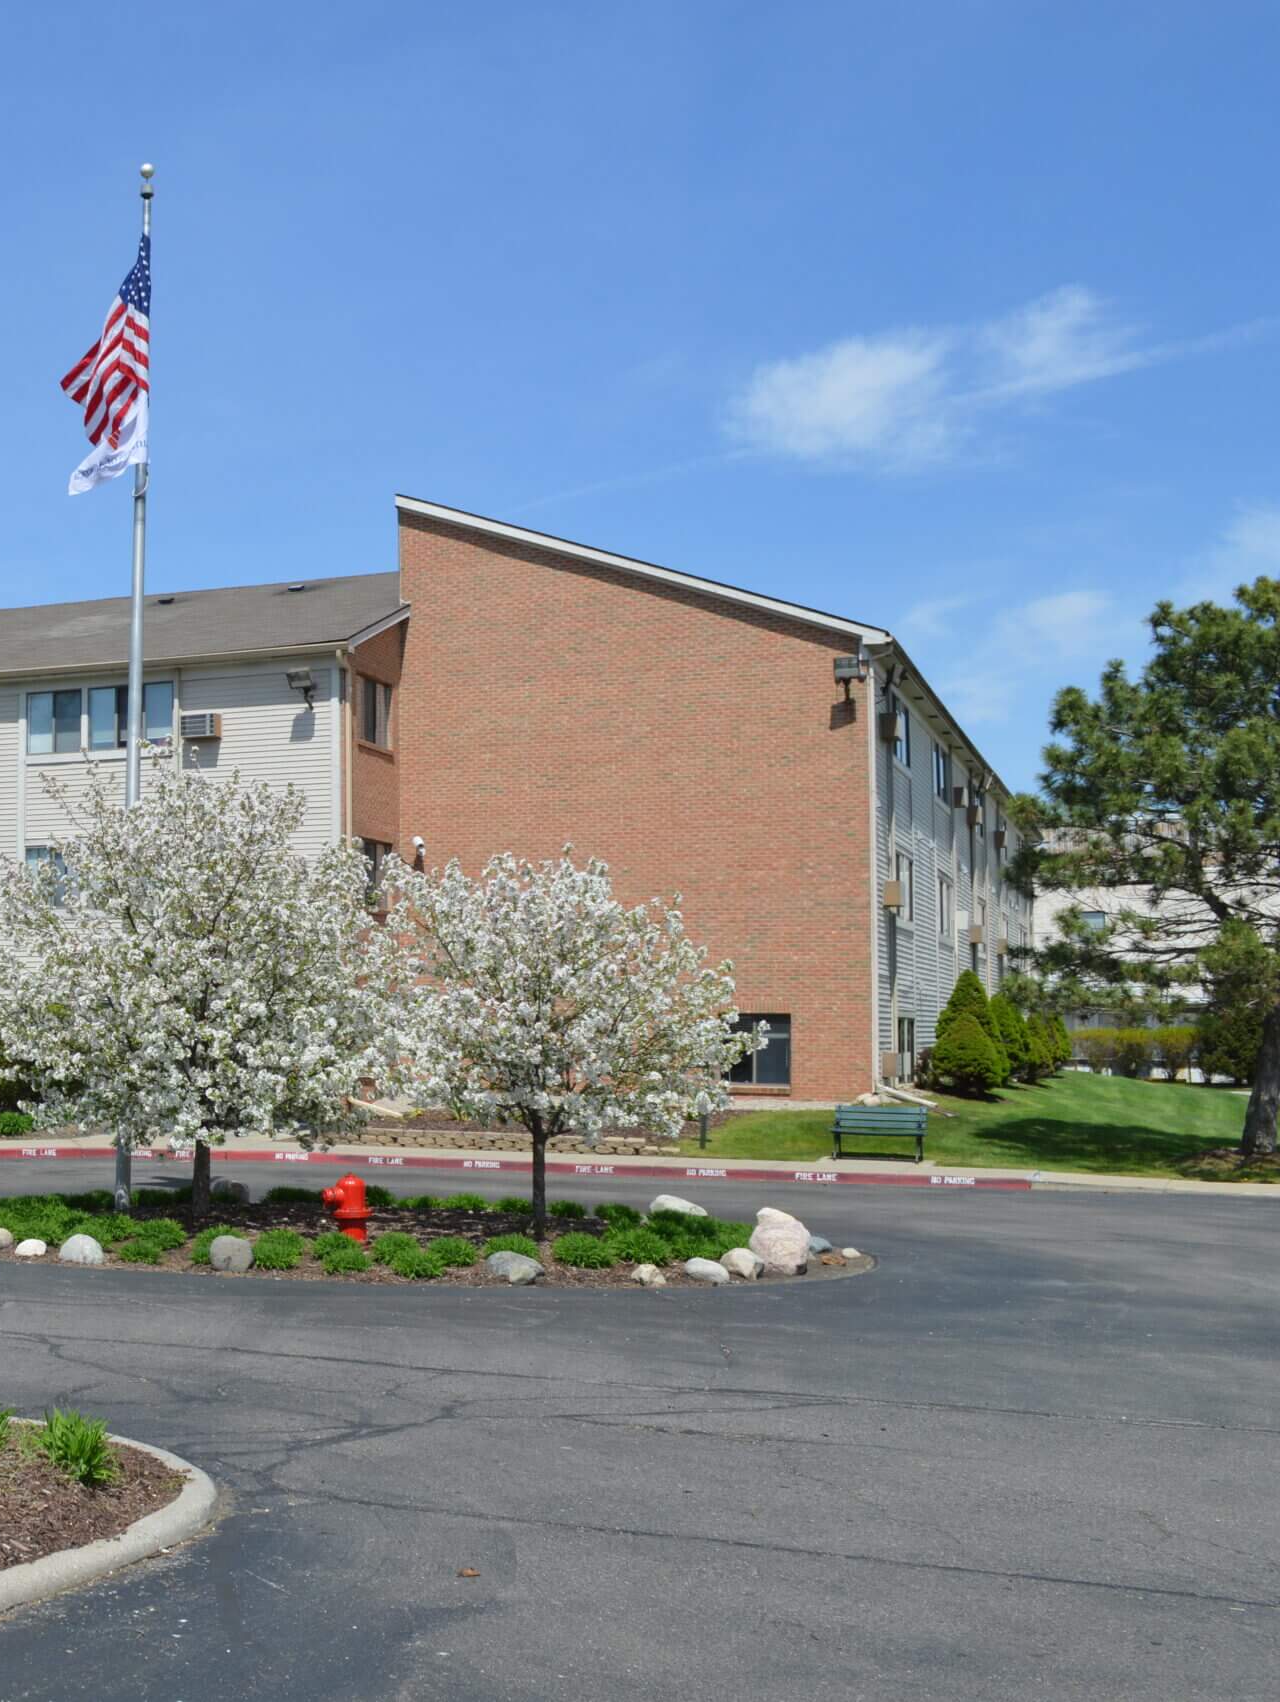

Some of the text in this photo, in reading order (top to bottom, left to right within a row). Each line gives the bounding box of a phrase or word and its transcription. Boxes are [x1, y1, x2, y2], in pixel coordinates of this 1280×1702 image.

[575, 1165, 592, 1173] FIRE
[686, 1168, 726, 1177] NO PARKING
[795, 1172, 837, 1181] FIRE LANE
[931, 1176, 975, 1184] NO PARKING
